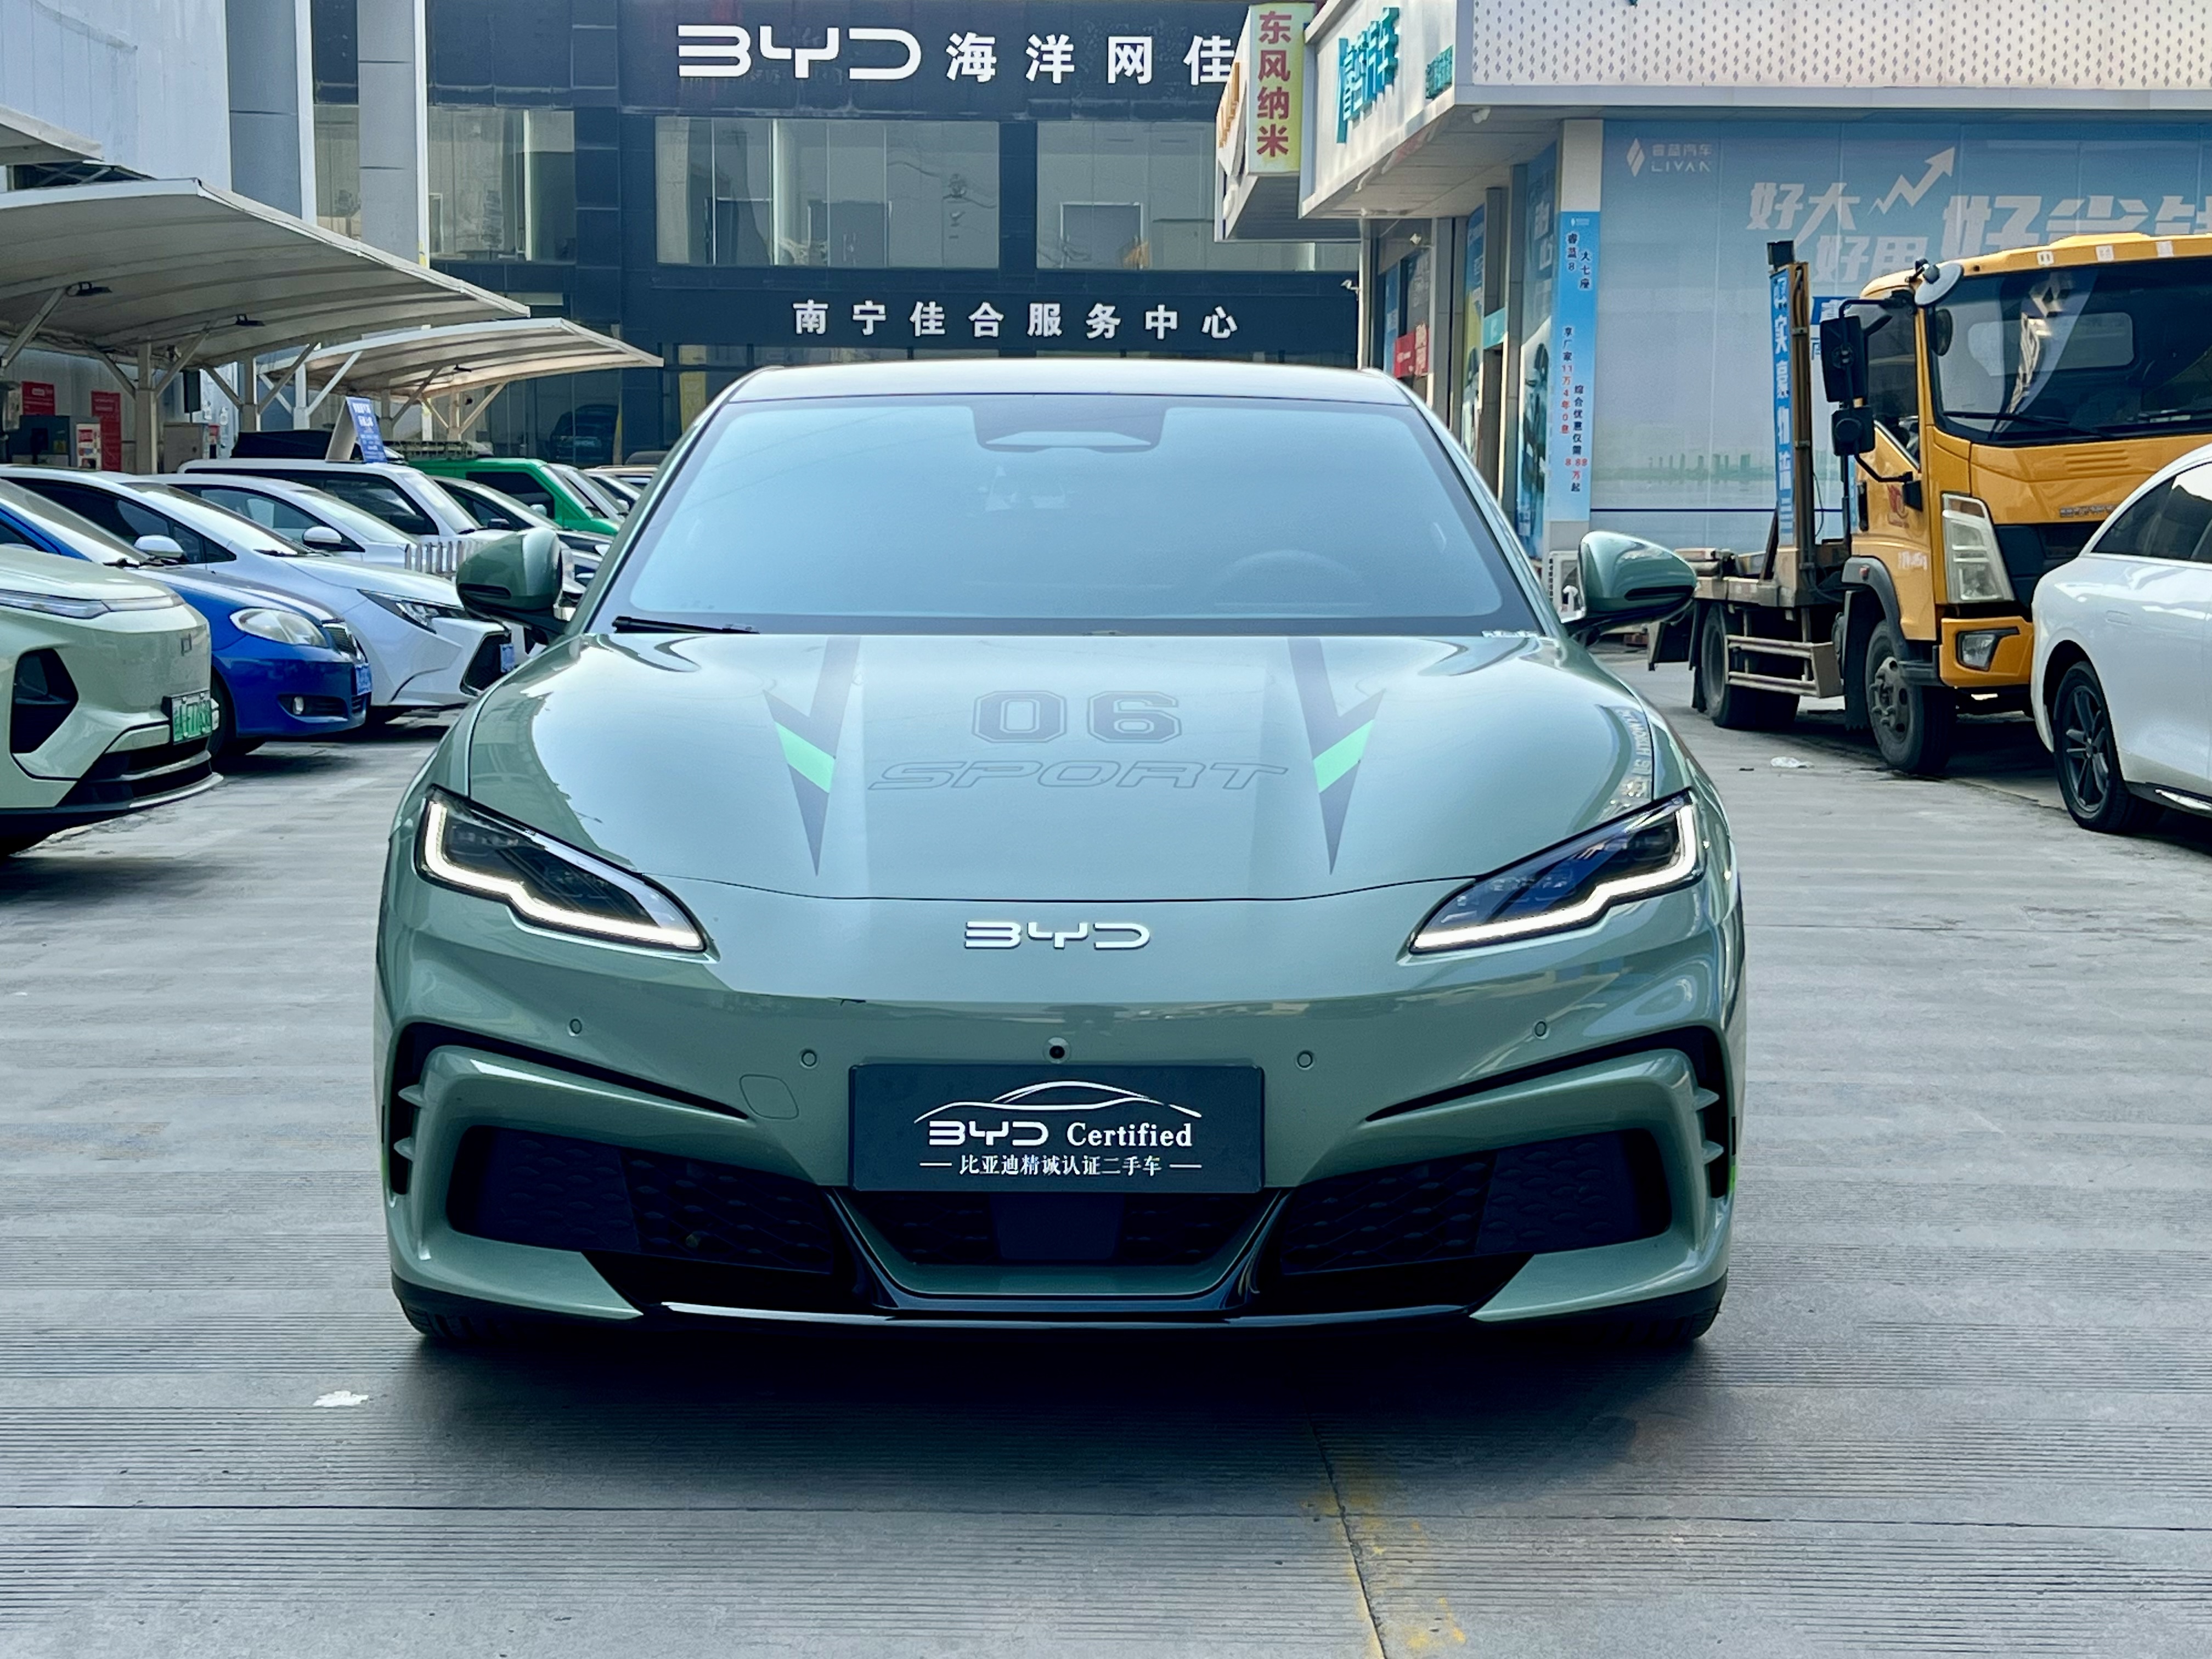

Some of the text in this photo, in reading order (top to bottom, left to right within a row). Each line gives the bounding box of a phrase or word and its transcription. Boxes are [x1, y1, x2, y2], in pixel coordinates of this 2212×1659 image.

[678, 25, 1234, 86] BYD 海洋网佳
[1256, 11, 1291, 157] 东风纳米
[1746, 182, 1860, 246] 好大
[1814, 235, 1928, 283] 好用
[793, 300, 1237, 339] 南宁佳合服务中心
[972, 691, 1182, 743] 06
[868, 760, 1289, 790] SPORT
[965, 922, 1150, 949] BYD
[929, 1121, 1192, 1146] BYD Certified
[960, 1154, 1162, 1176] 比亚迪精诚认证二手车
